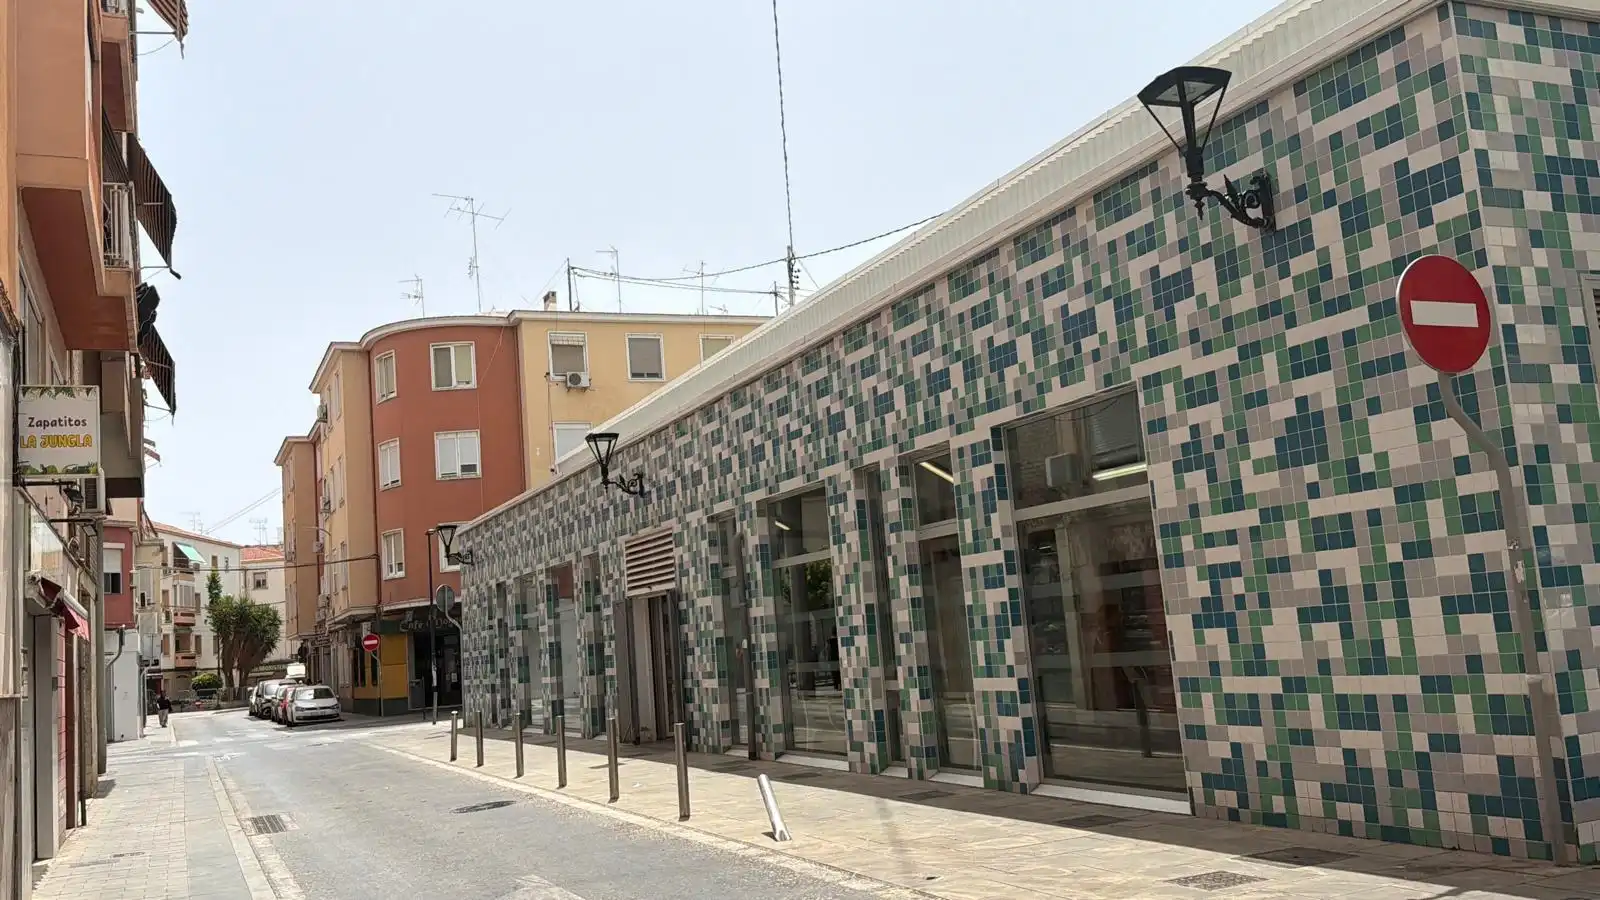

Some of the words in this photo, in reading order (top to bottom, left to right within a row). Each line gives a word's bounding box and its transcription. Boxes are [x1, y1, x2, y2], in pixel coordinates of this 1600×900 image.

[28, 415, 87, 430] Zapatitos
[19, 434, 37, 449] LA
[40, 434, 92, 449] JUNGLA
